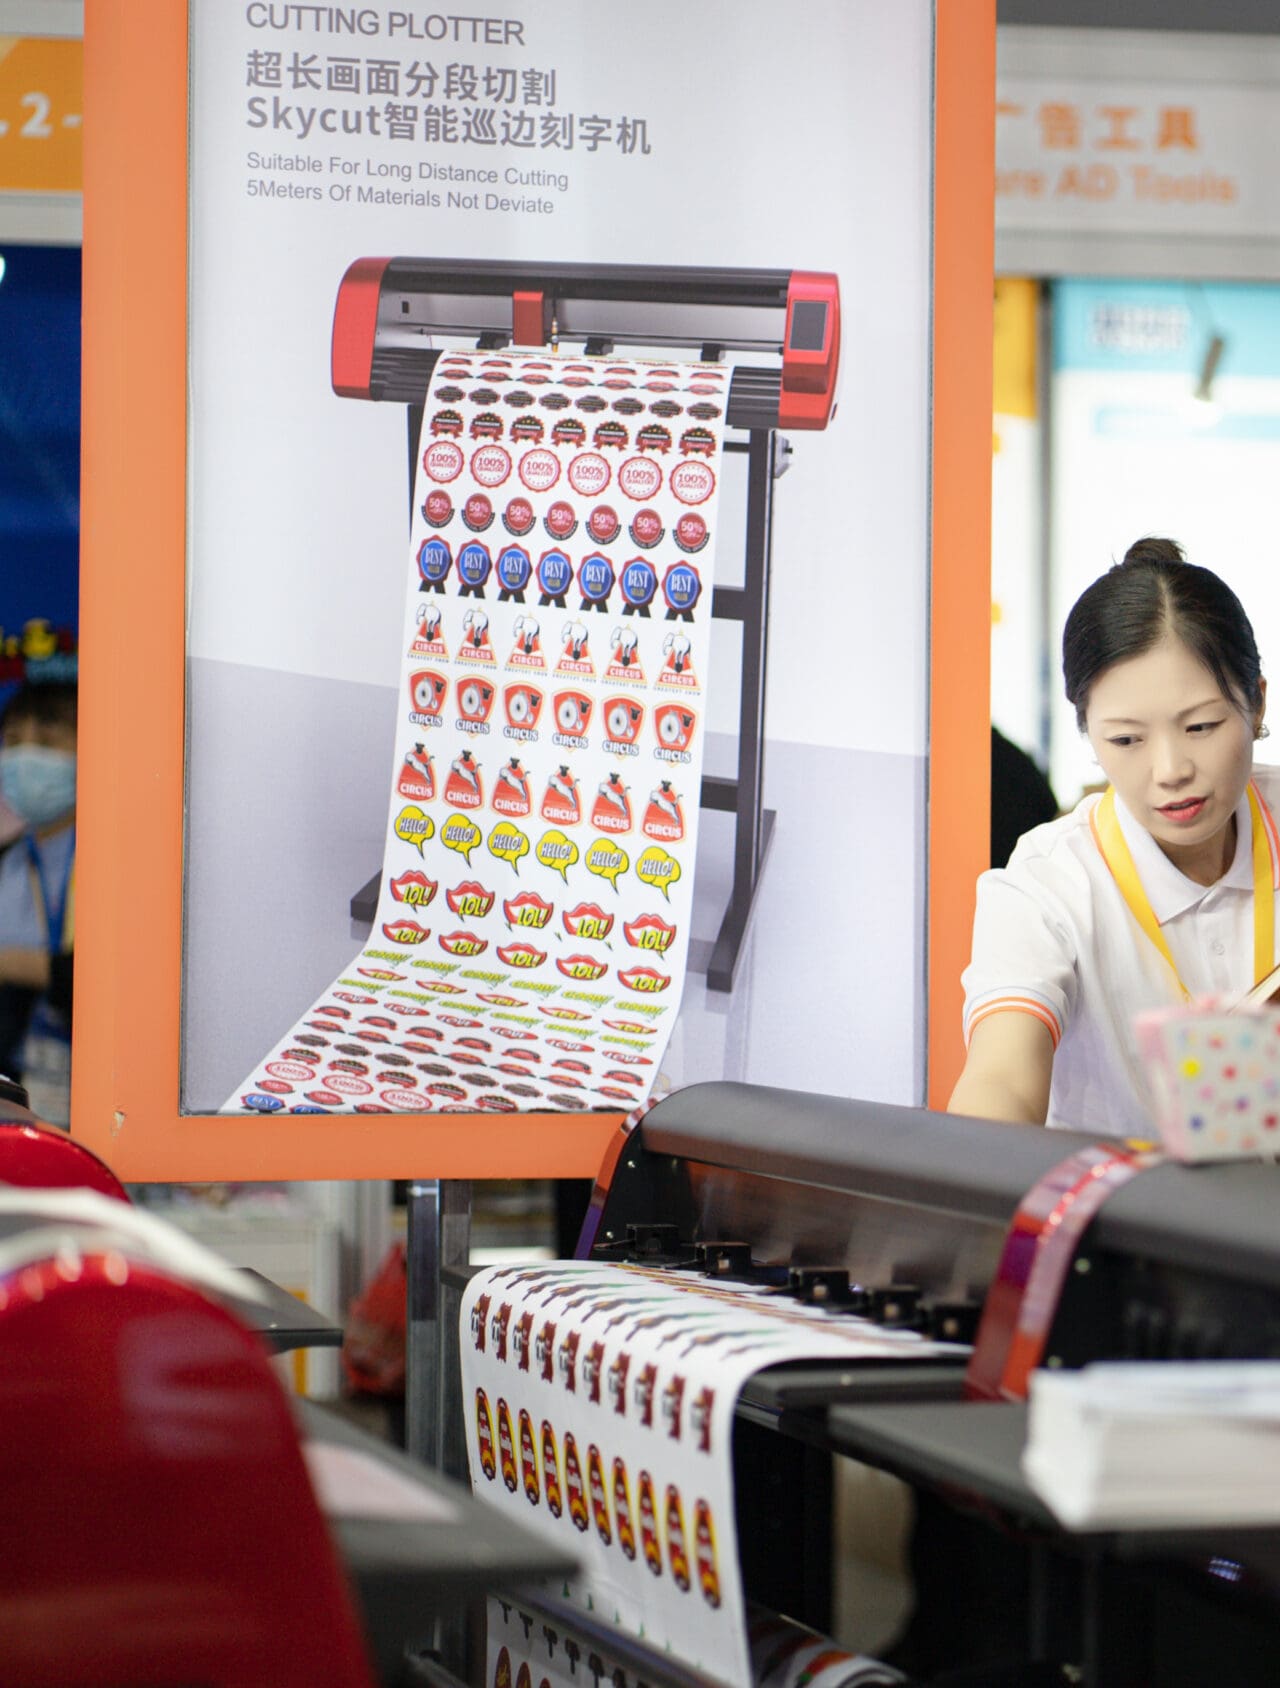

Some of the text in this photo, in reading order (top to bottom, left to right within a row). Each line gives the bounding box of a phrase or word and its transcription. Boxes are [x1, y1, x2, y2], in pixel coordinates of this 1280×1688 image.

[246, 2, 525, 46] CUTTING PLOTTER
[246, 49, 556, 106] 超长画面分段切割
[246, 96, 651, 155] Skycut智能巡边刻字机
[247, 152, 569, 191] Suitable For Long Distance Cutting
[247, 180, 554, 215] 5Meters Of Materials Not Deviate
[431, 453, 457, 463] 100%
[478, 457, 505, 467] 100%
[526, 461, 553, 471] 100%
[576, 465, 603, 475] 100%
[627, 470, 655, 480] 100%
[678, 474, 707, 484] 100%
[429, 498, 448, 509] 50%
[469, 501, 489, 512] 50%
[509, 505, 530, 516] 50%
[551, 509, 572, 520] 50%
[593, 513, 615, 525] 50%
[636, 517, 658, 528] 50%
[681, 521, 703, 532] 50%
[425, 548, 444, 565] BEST
[464, 552, 483, 570] BEST
[504, 556, 523, 574] BEST
[544, 560, 564, 578] BEST
[586, 565, 606, 583] BEST
[628, 569, 649, 588] BEST
[671, 574, 692, 592] BEST
[415, 642, 443, 653] CIRCUS
[462, 648, 491, 659] CIRCUS
[513, 655, 542, 666] CIRCUS
[561, 661, 590, 672] CIRCUS
[610, 667, 640, 679] CIRCUS
[662, 674, 694, 686] CIRCUS
[409, 712, 443, 727] CIRCUS
[456, 719, 490, 734] CIRCUS
[503, 725, 539, 741] CIRCUS
[552, 733, 588, 749] CIRCUS
[602, 740, 640, 756] CIRCUS
[653, 747, 692, 763] CIRCUS
[400, 783, 433, 797] CIRCUS
[447, 791, 480, 805] CIRCUS
[494, 799, 528, 813] CIRCUS
[543, 806, 579, 821] CIRCUS
[399, 818, 429, 834] HELLO!
[593, 815, 630, 829] CIRCUS
[446, 826, 476, 843] HELLO!
[645, 823, 682, 838] CIRCUS
[493, 834, 524, 851] HELLO!
[542, 843, 574, 860] HELLO!
[590, 851, 624, 868] HELLO!
[640, 859, 674, 877] HELLO!
[403, 885, 433, 906] LOL!
[459, 896, 490, 918] LOL!
[517, 907, 549, 928] LOL!
[394, 929, 425, 944] LOL!
[576, 918, 609, 940] LOL!
[638, 929, 671, 951] LOL!
[450, 941, 483, 956] LOL!
[510, 952, 542, 967] LOL!
[569, 965, 603, 980] LOL!
[632, 975, 665, 992] LOL!
